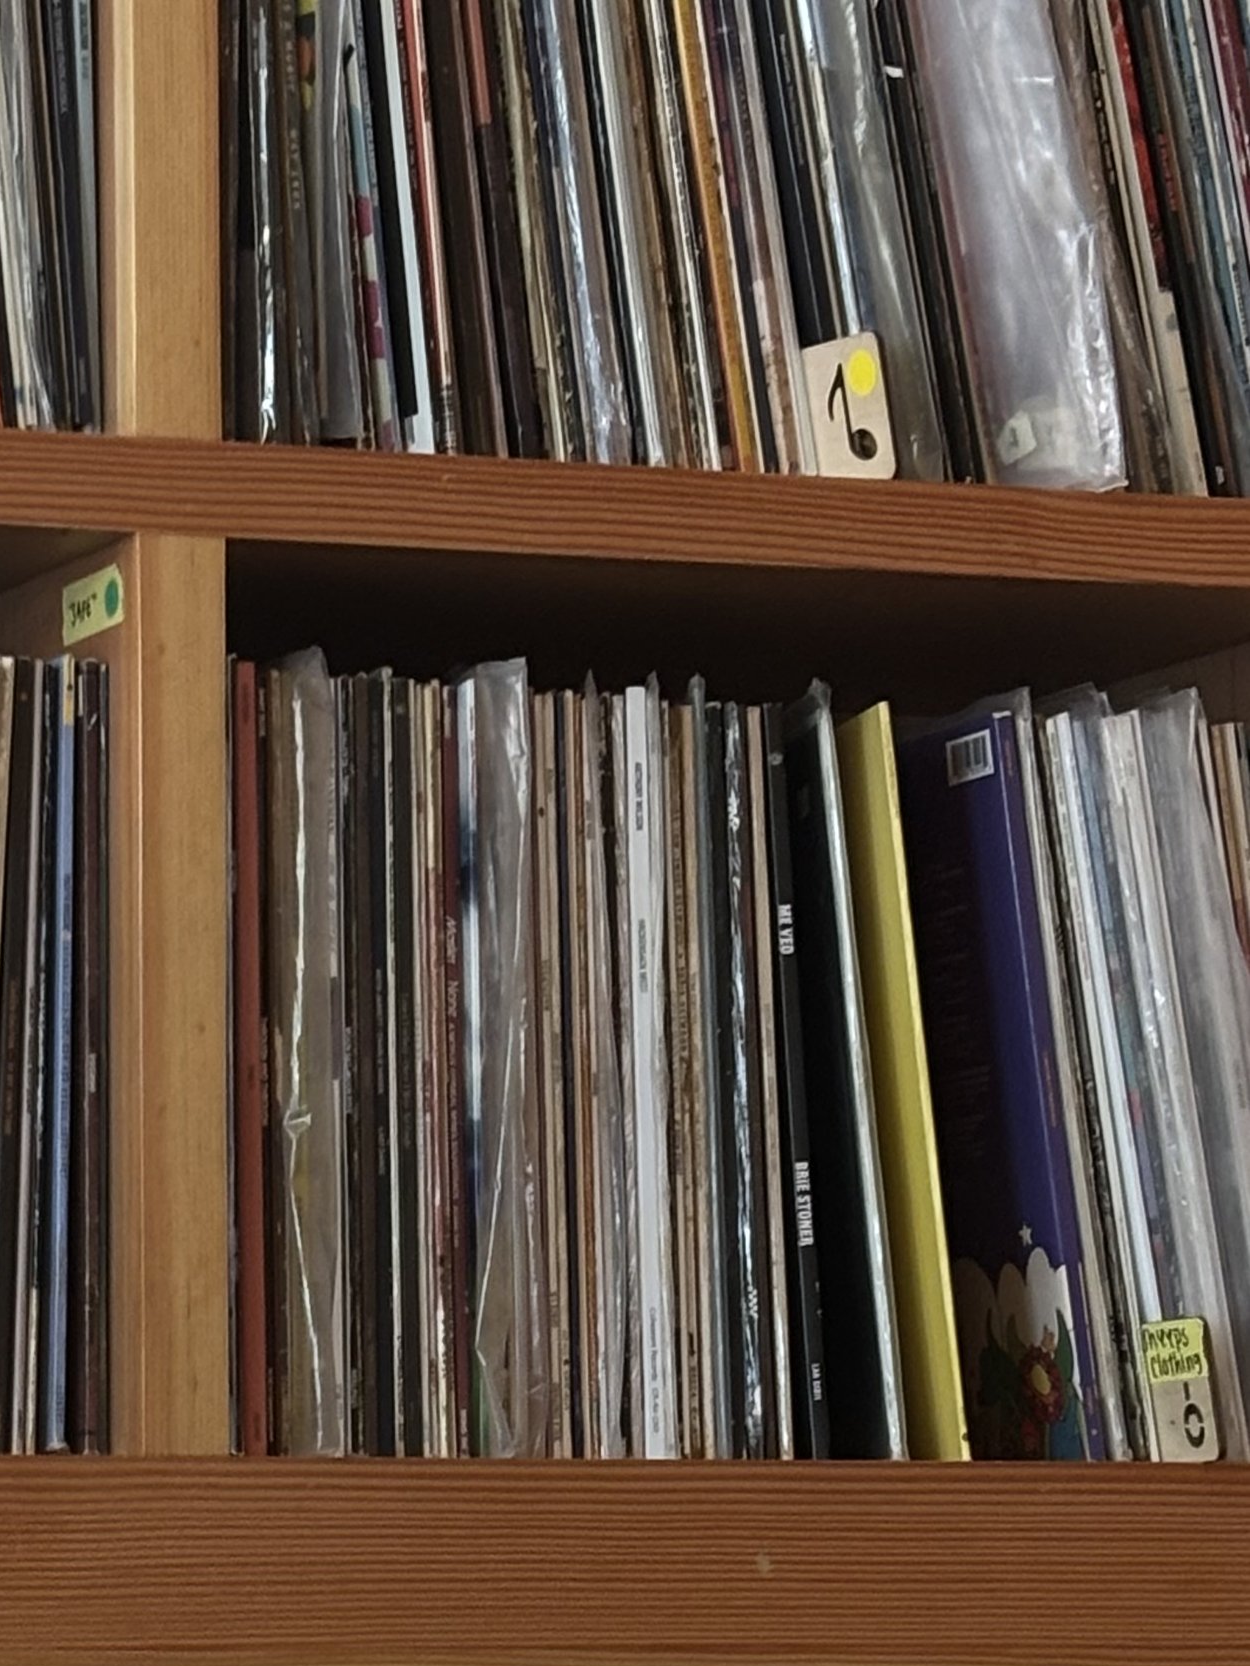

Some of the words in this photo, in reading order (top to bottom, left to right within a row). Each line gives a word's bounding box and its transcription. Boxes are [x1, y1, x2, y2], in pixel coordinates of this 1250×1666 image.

[776, 903, 792, 925] ME
[794, 1161, 810, 1191] BRIE
[795, 1193, 814, 1246] STONER
